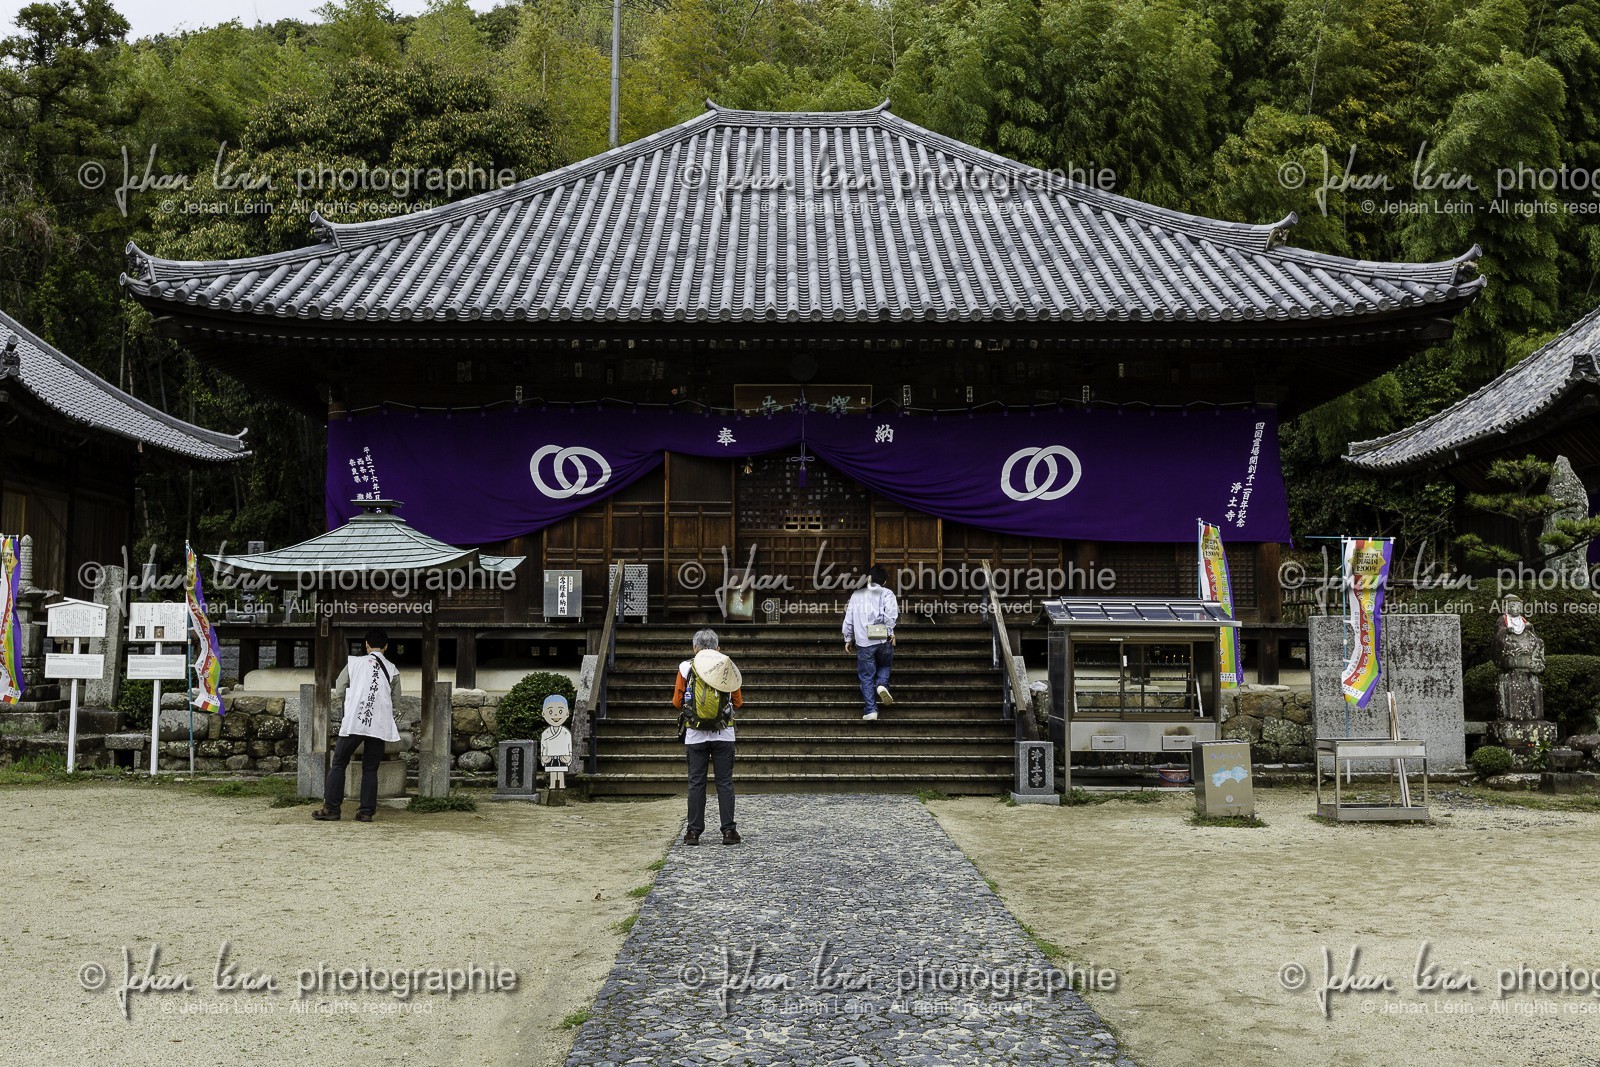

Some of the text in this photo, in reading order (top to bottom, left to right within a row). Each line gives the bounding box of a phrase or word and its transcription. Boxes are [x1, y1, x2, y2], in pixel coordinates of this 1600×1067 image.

[716, 424, 894, 446] 奉 納
[1225, 482, 1242, 522] 浄土寺
[1030, 748, 1043, 786] 浄土寺
